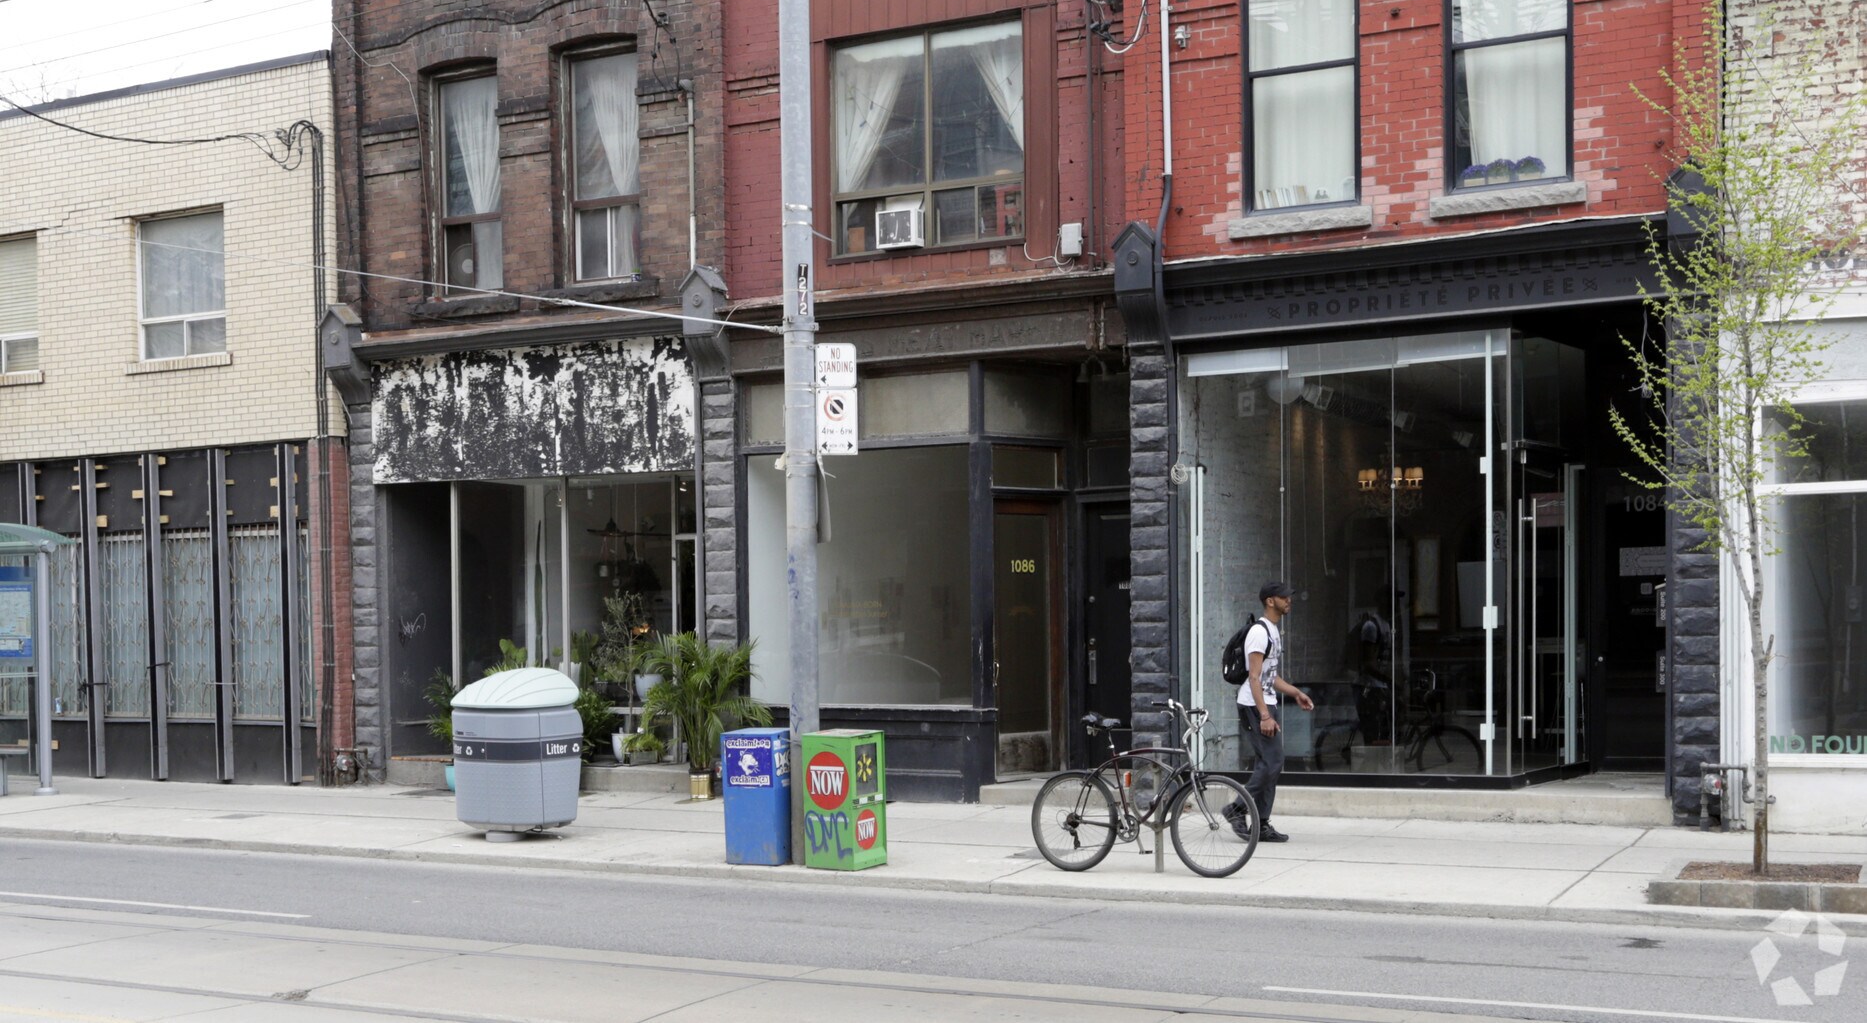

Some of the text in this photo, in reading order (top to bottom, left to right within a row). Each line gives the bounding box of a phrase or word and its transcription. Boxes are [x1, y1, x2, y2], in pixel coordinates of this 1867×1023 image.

[799, 264, 808, 315] T272
[830, 347, 841, 360] NO
[818, 360, 854, 374] STANDING
[1010, 559, 1035, 574] 1086
[546, 743, 568, 756] Litter
[1811, 735, 1867, 754] FOU
[810, 770, 844, 796] NOW
[858, 820, 875, 842] NOW
